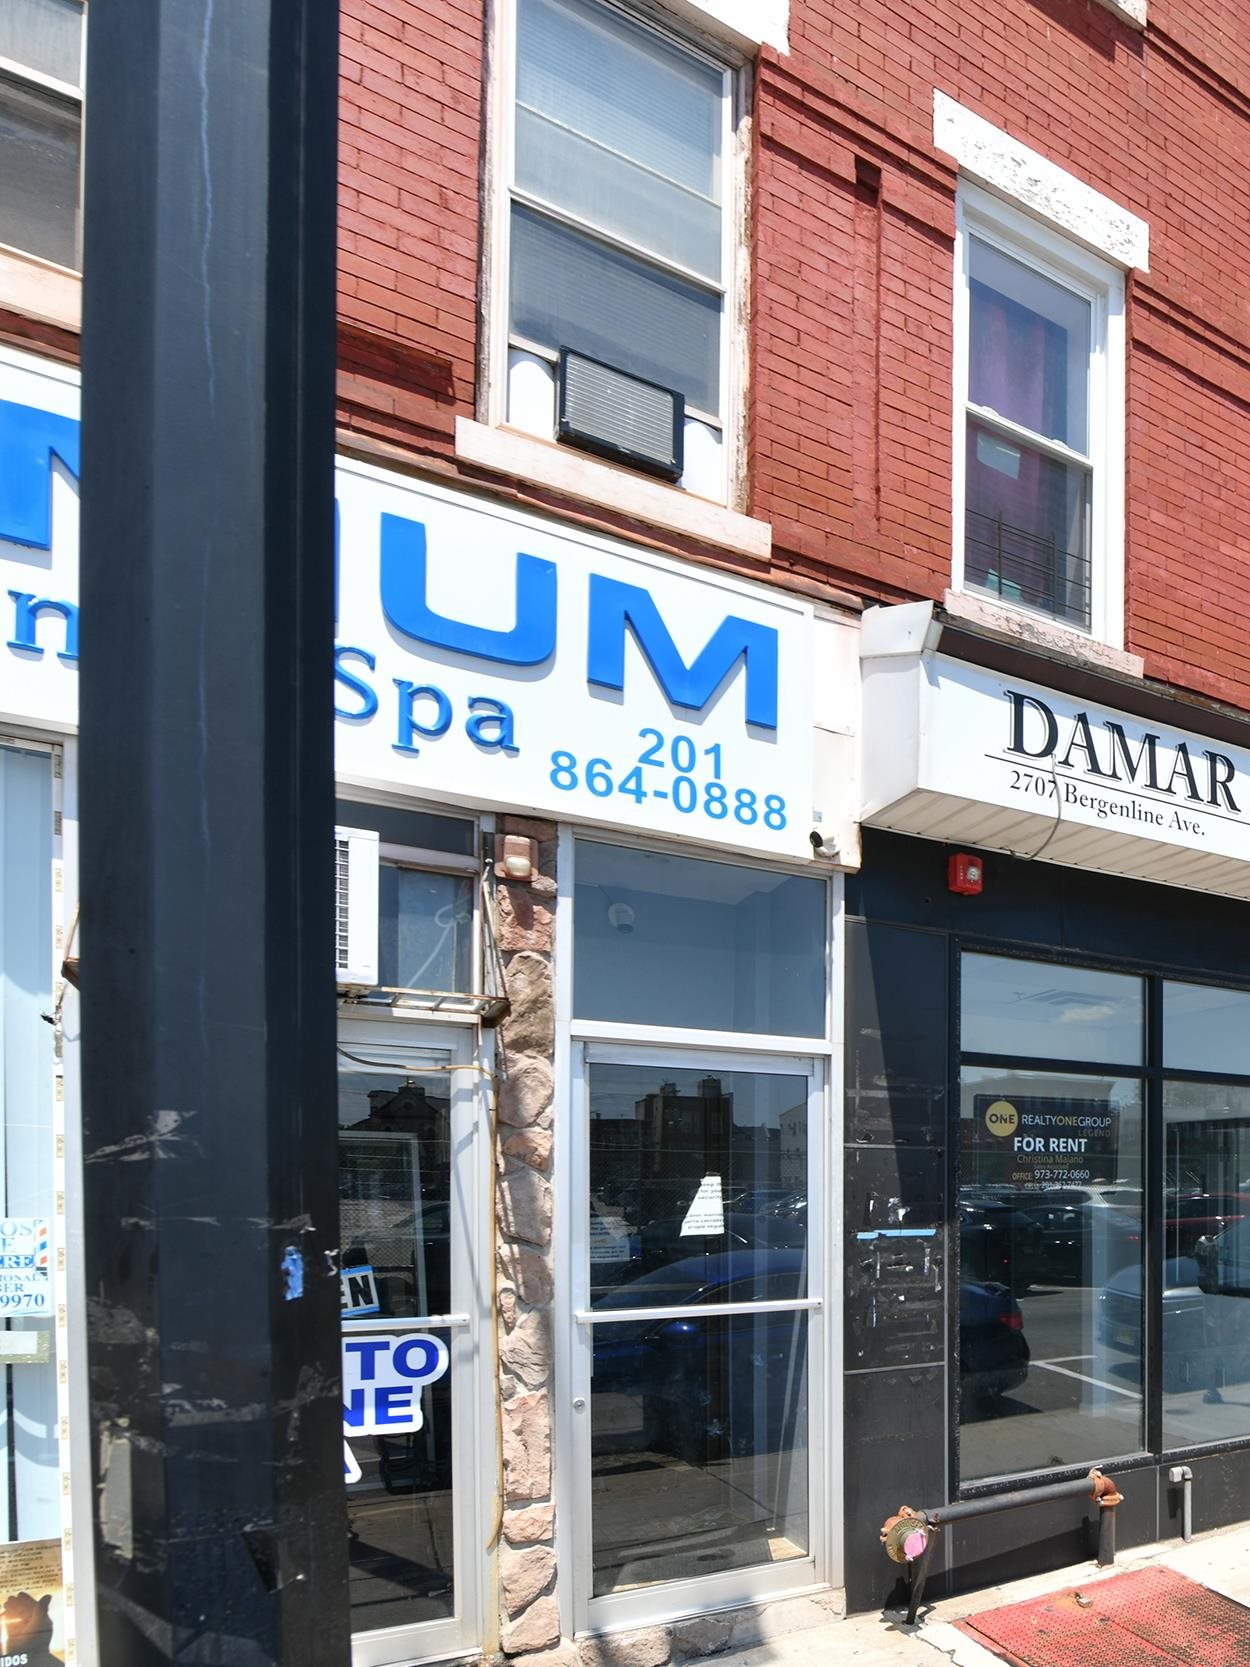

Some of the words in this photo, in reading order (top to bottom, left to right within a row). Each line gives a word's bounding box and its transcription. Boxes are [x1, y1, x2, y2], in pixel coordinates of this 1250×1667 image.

[637, 727, 724, 781] 201
[1003, 688, 1241, 813] DAMAR
[549, 750, 787, 832] 864-0888
[1009, 769, 1060, 796] 2707
[1063, 780, 1166, 829] Bergenline
[1168, 814, 1206, 837] Ave.
[989, 1113, 1015, 1125] ONE
[1021, 1114, 1112, 1128] REALTYONEGROUP
[1013, 1137, 1045, 1152] FOR
[1049, 1138, 1088, 1152] RENT
[1034, 1169, 1090, 1180] 973-772-0660
